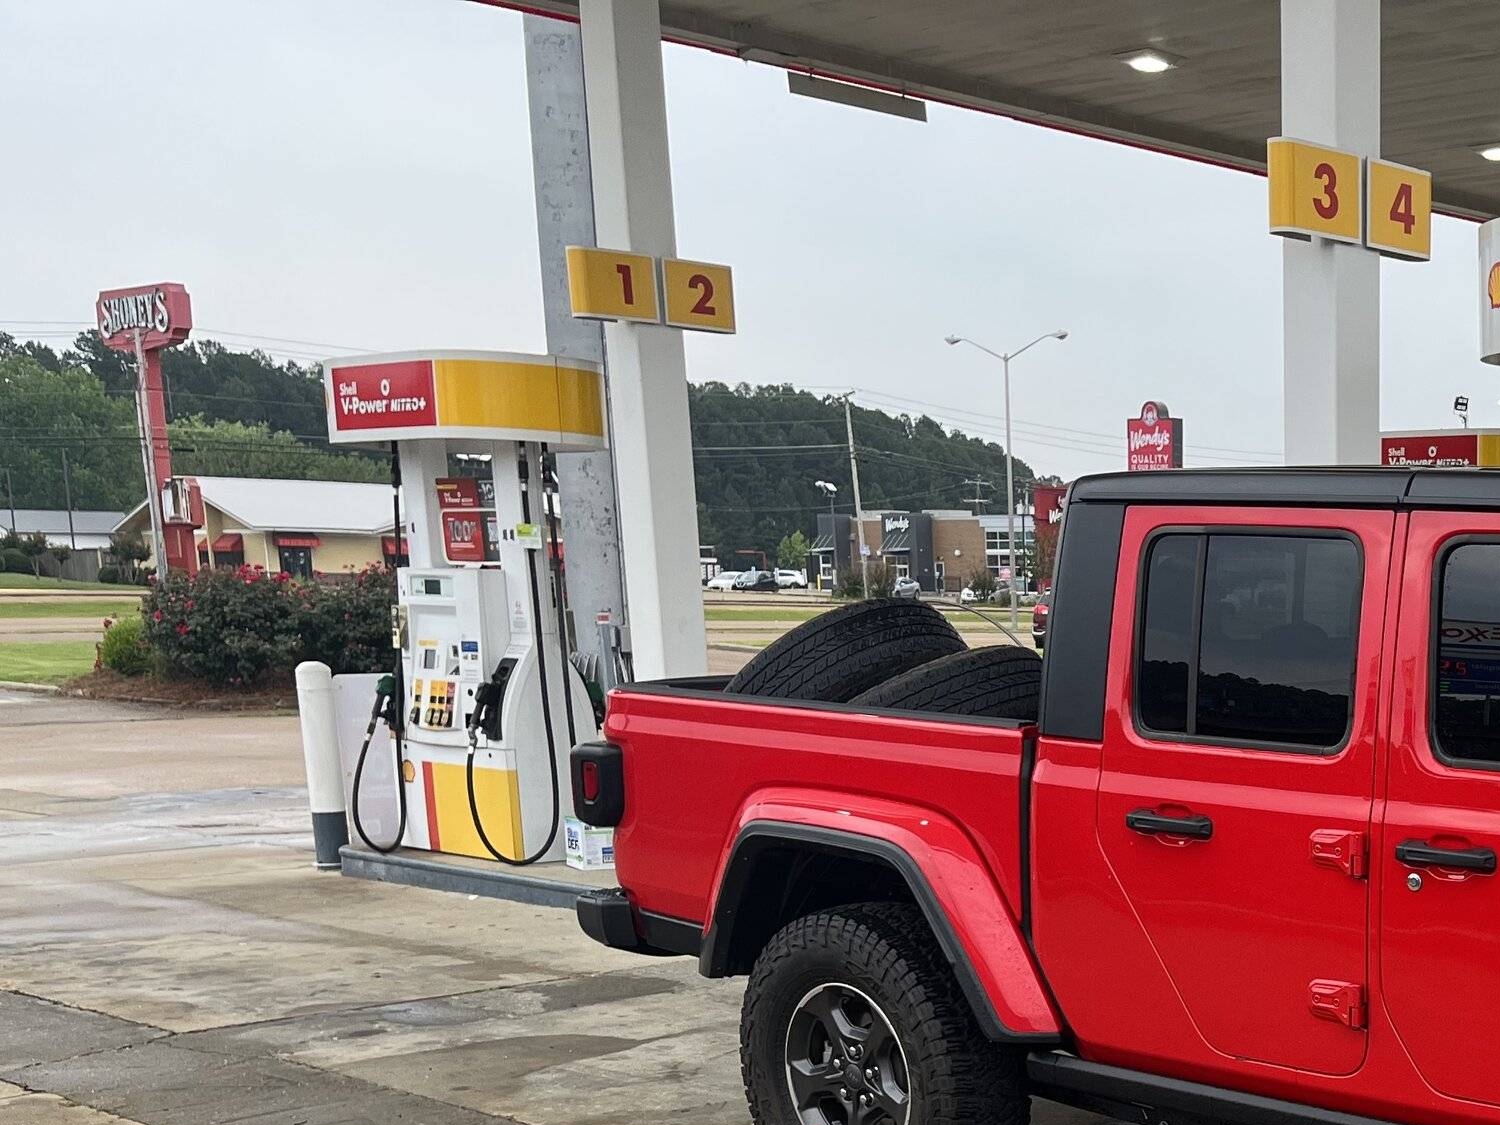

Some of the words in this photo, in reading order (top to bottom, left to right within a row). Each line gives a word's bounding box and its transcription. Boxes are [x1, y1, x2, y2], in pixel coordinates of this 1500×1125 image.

[1312, 163, 1339, 220] 3
[1389, 183, 1416, 235] 4
[616, 263, 634, 305] 1
[688, 273, 716, 316] 2
[101, 290, 169, 339] SHONEY'S
[339, 381, 357, 397] Shell
[340, 397, 388, 415] V-Power
[1130, 426, 1170, 451] Wendy's
[1388, 447, 1405, 456] Shell
[1131, 454, 1169, 463] QUALITY
